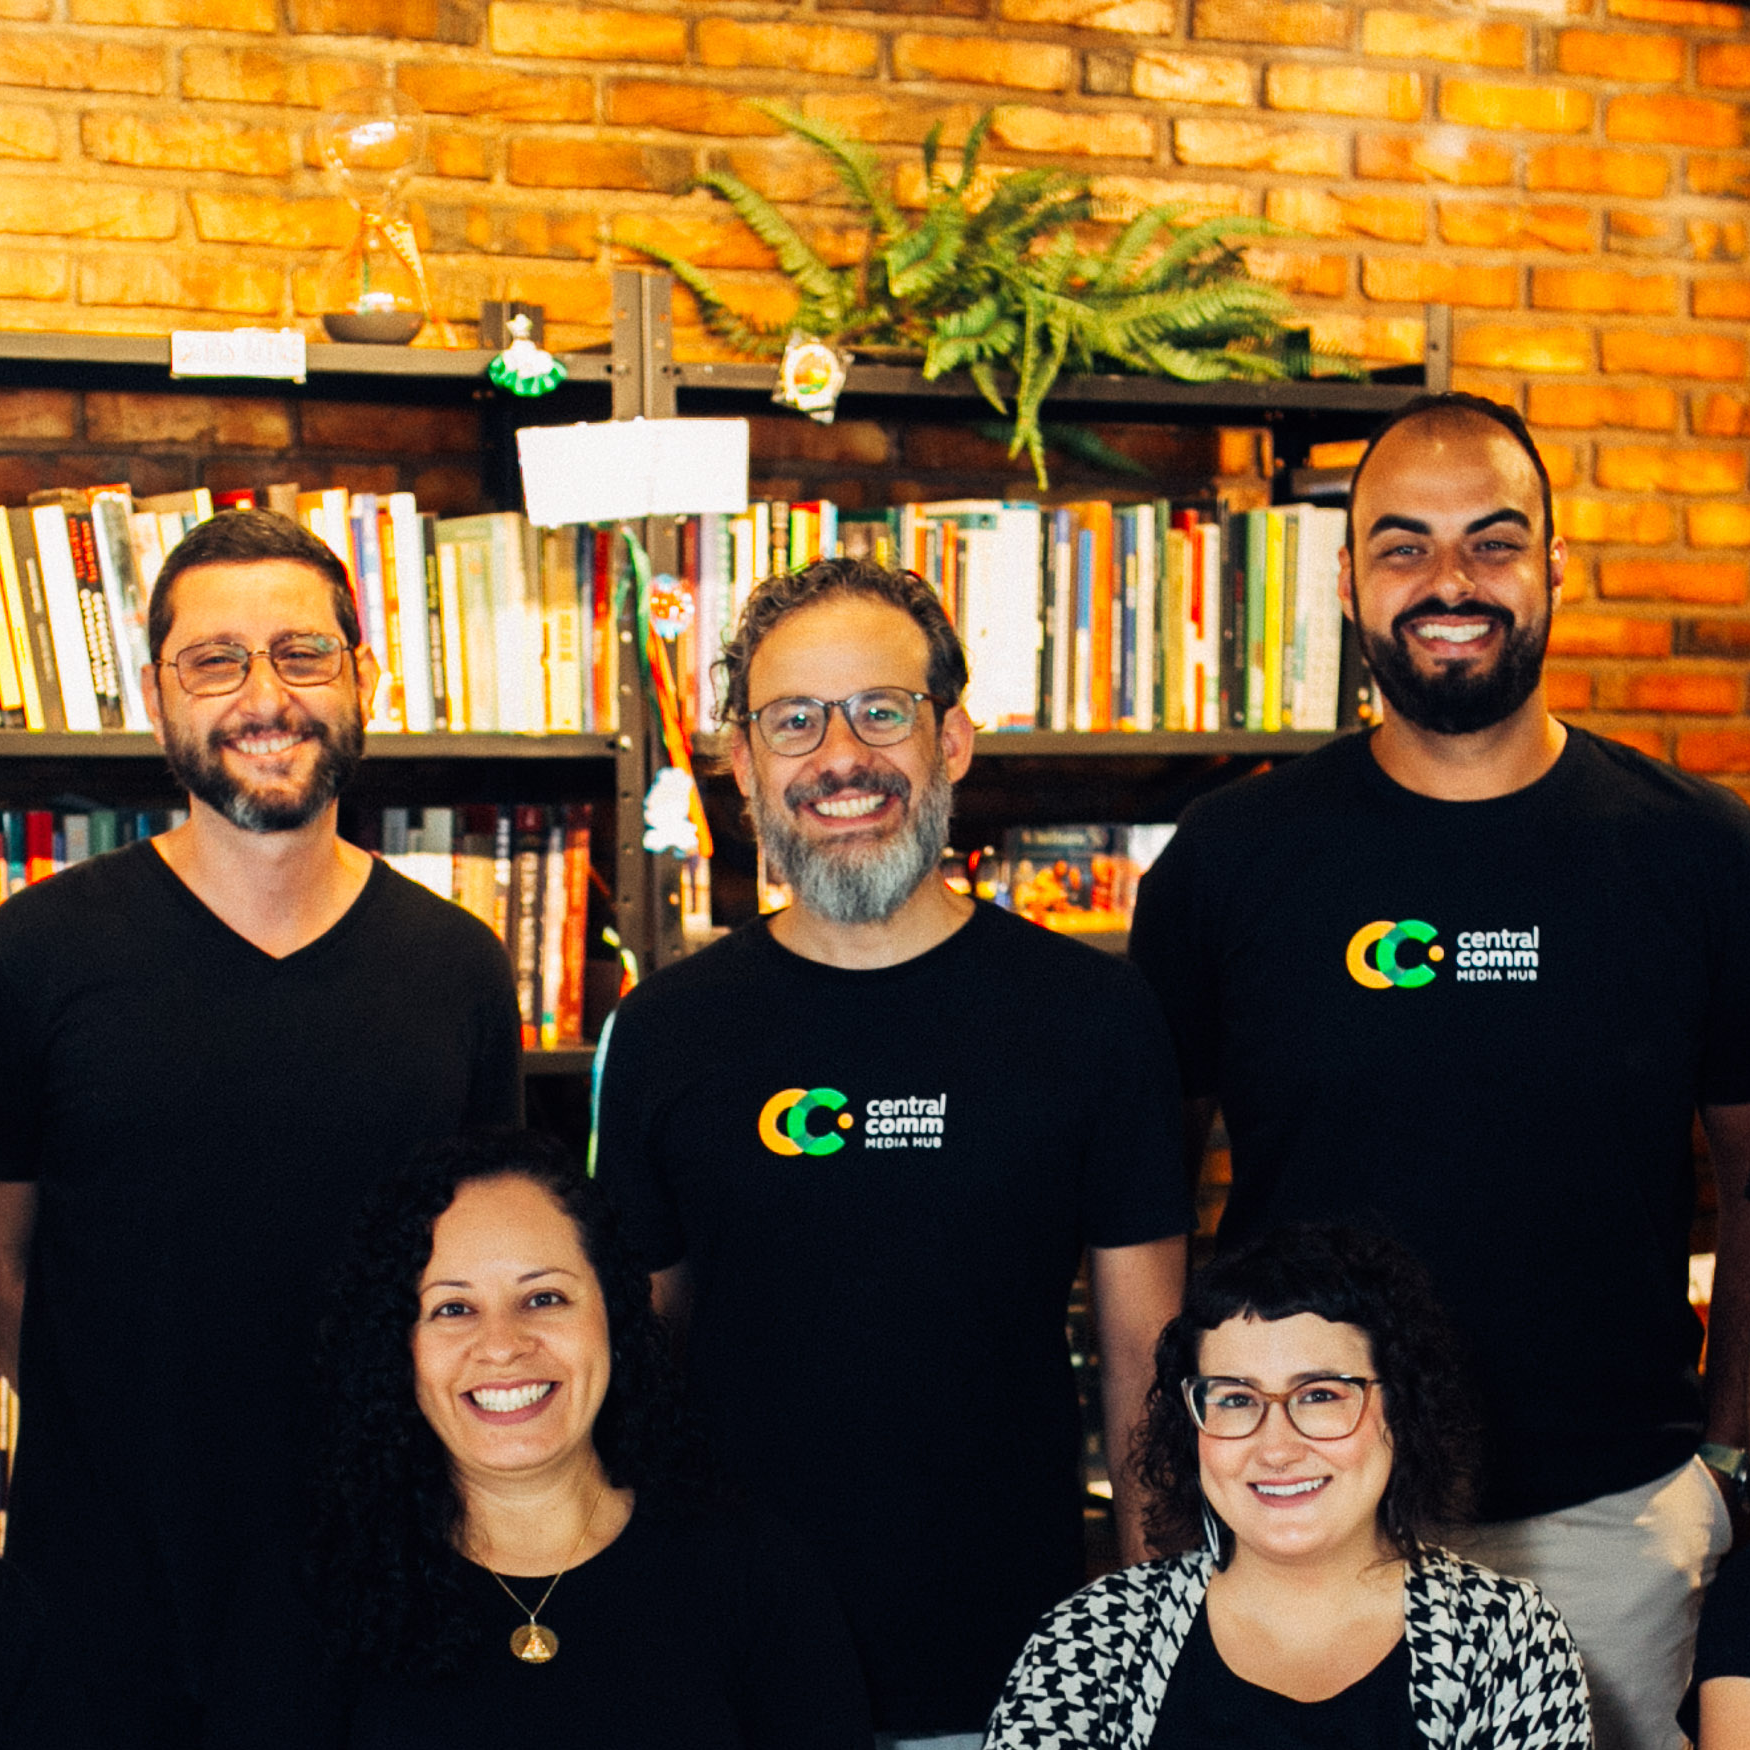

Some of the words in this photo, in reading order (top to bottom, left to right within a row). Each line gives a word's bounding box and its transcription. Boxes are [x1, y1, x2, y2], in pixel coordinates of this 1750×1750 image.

[1457, 925, 1539, 949] central
[1456, 950, 1539, 967] comm
[1456, 969, 1502, 981] MEDIA
[1507, 969, 1537, 981] HUB
[866, 1093, 947, 1116] central
[865, 1117, 944, 1135] comm
[865, 1137, 908, 1149] MEDIA
[913, 1136, 942, 1148] HUB
